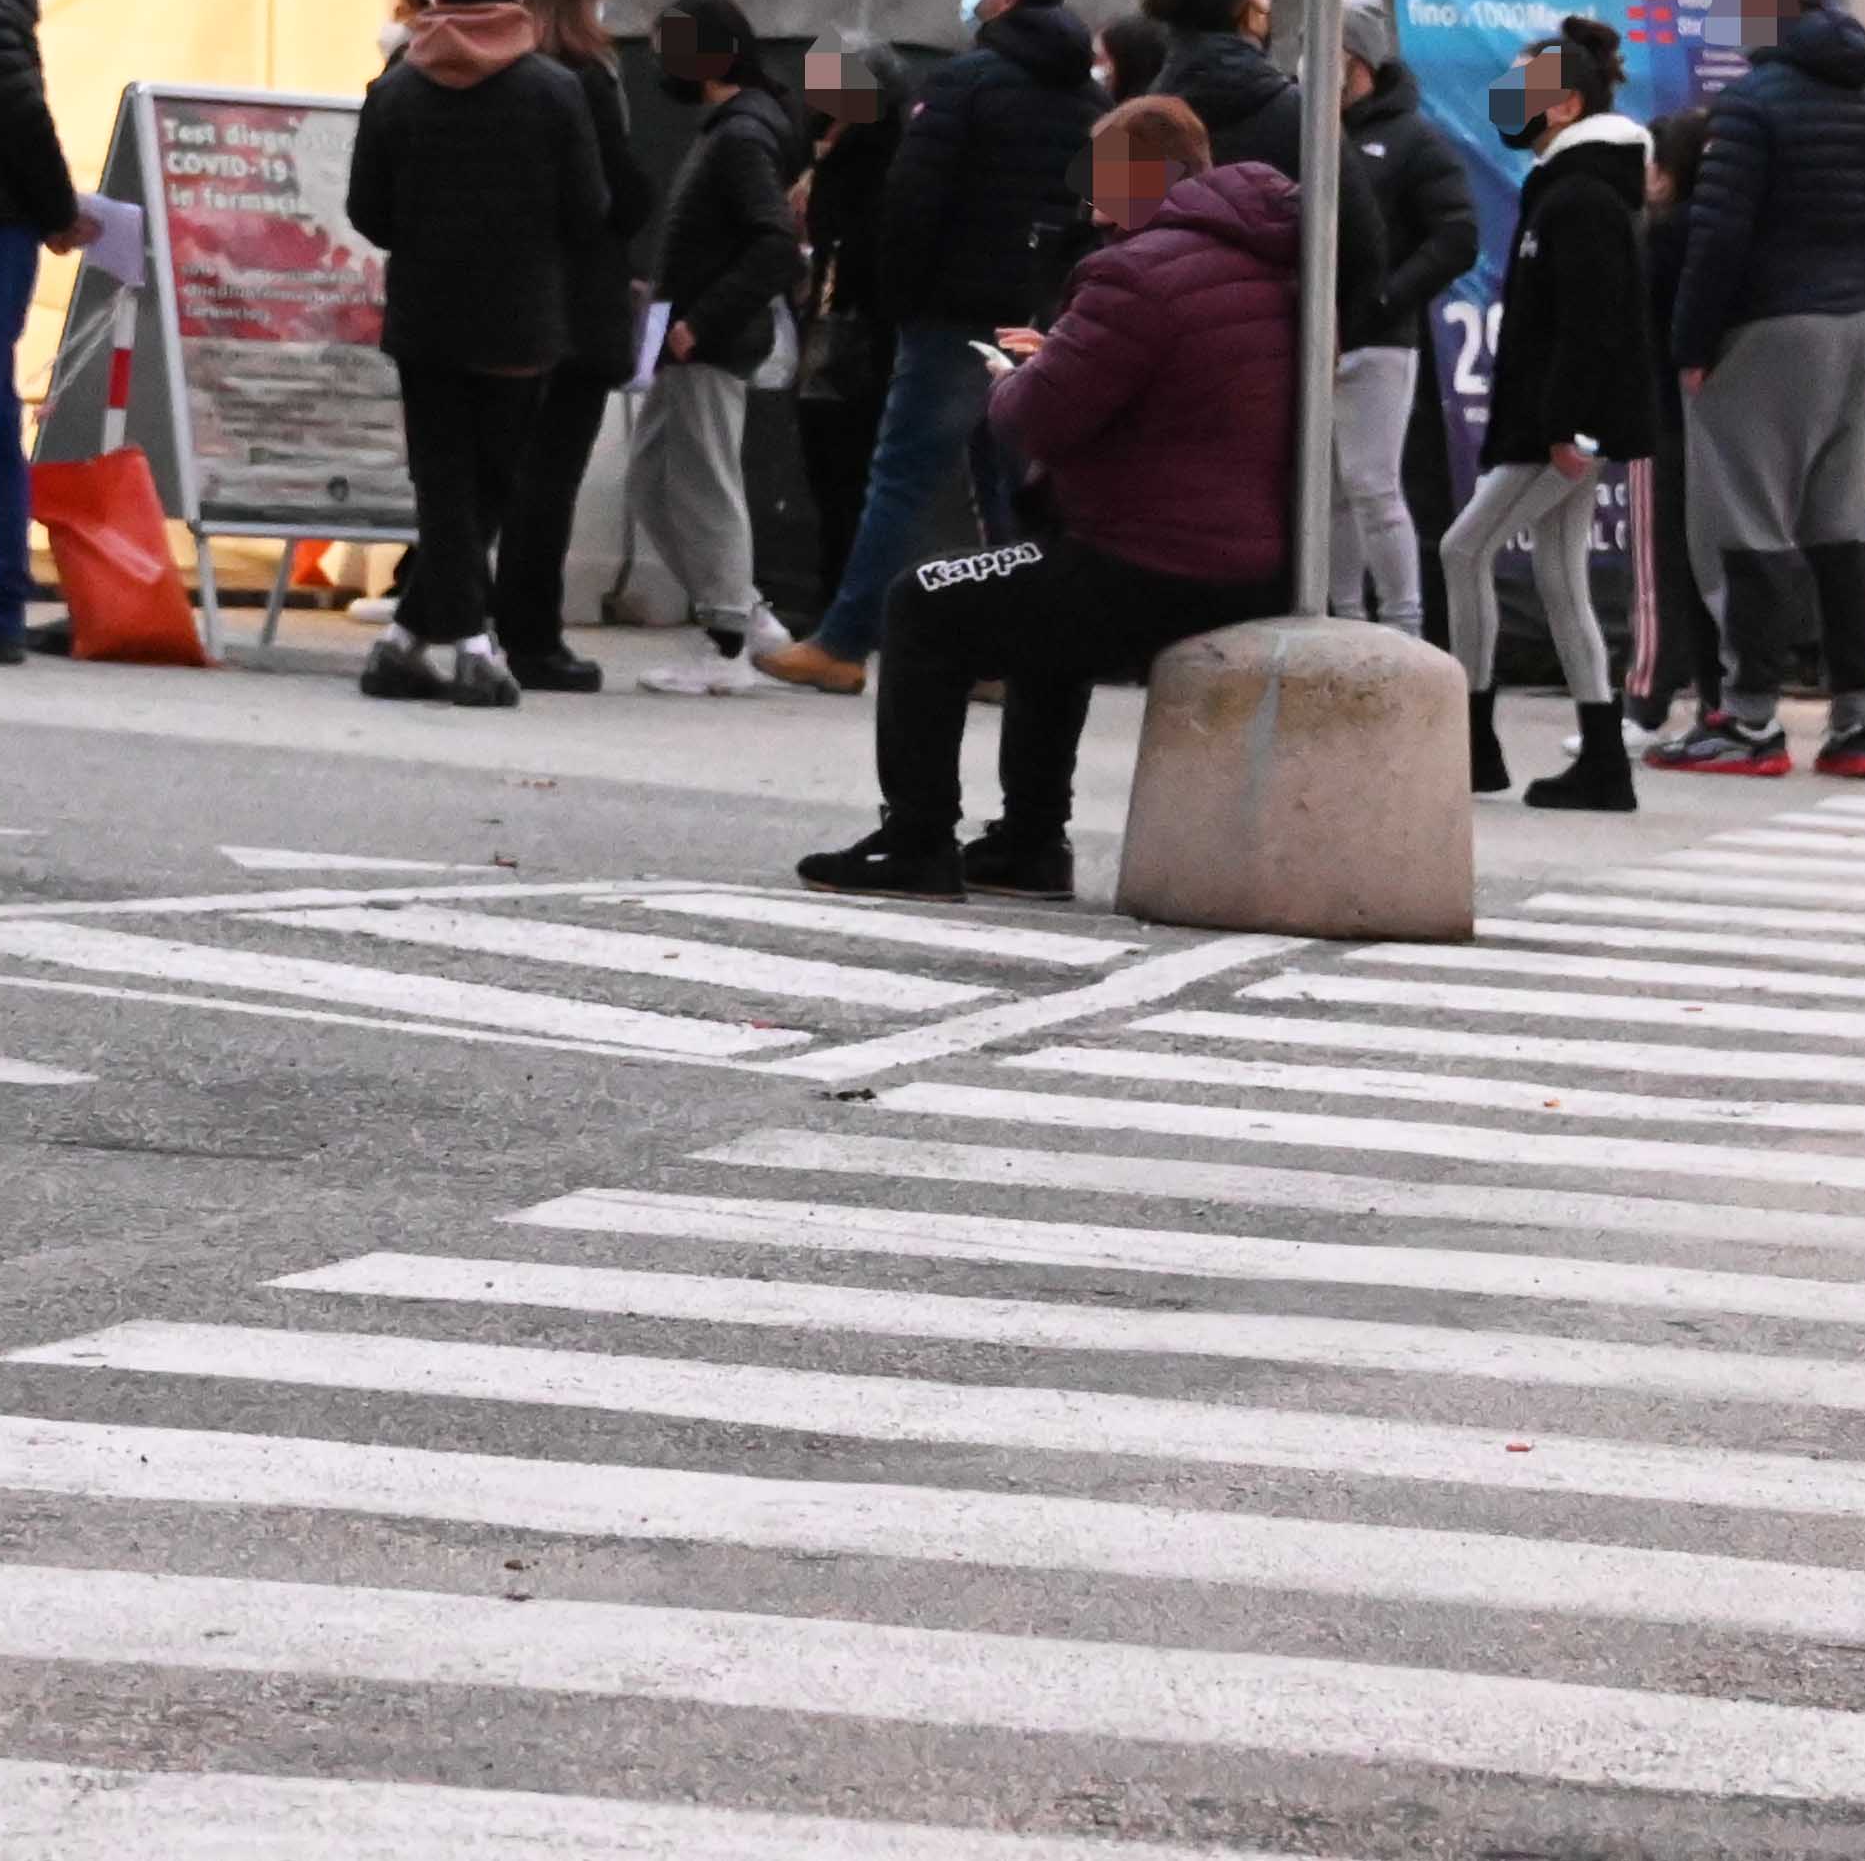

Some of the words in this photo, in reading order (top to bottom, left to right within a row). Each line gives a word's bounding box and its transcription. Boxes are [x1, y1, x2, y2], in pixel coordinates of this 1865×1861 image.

[162, 117, 217, 146] Test
[167, 150, 288, 183] COVID-19
[916, 541, 1044, 592] Kappa
